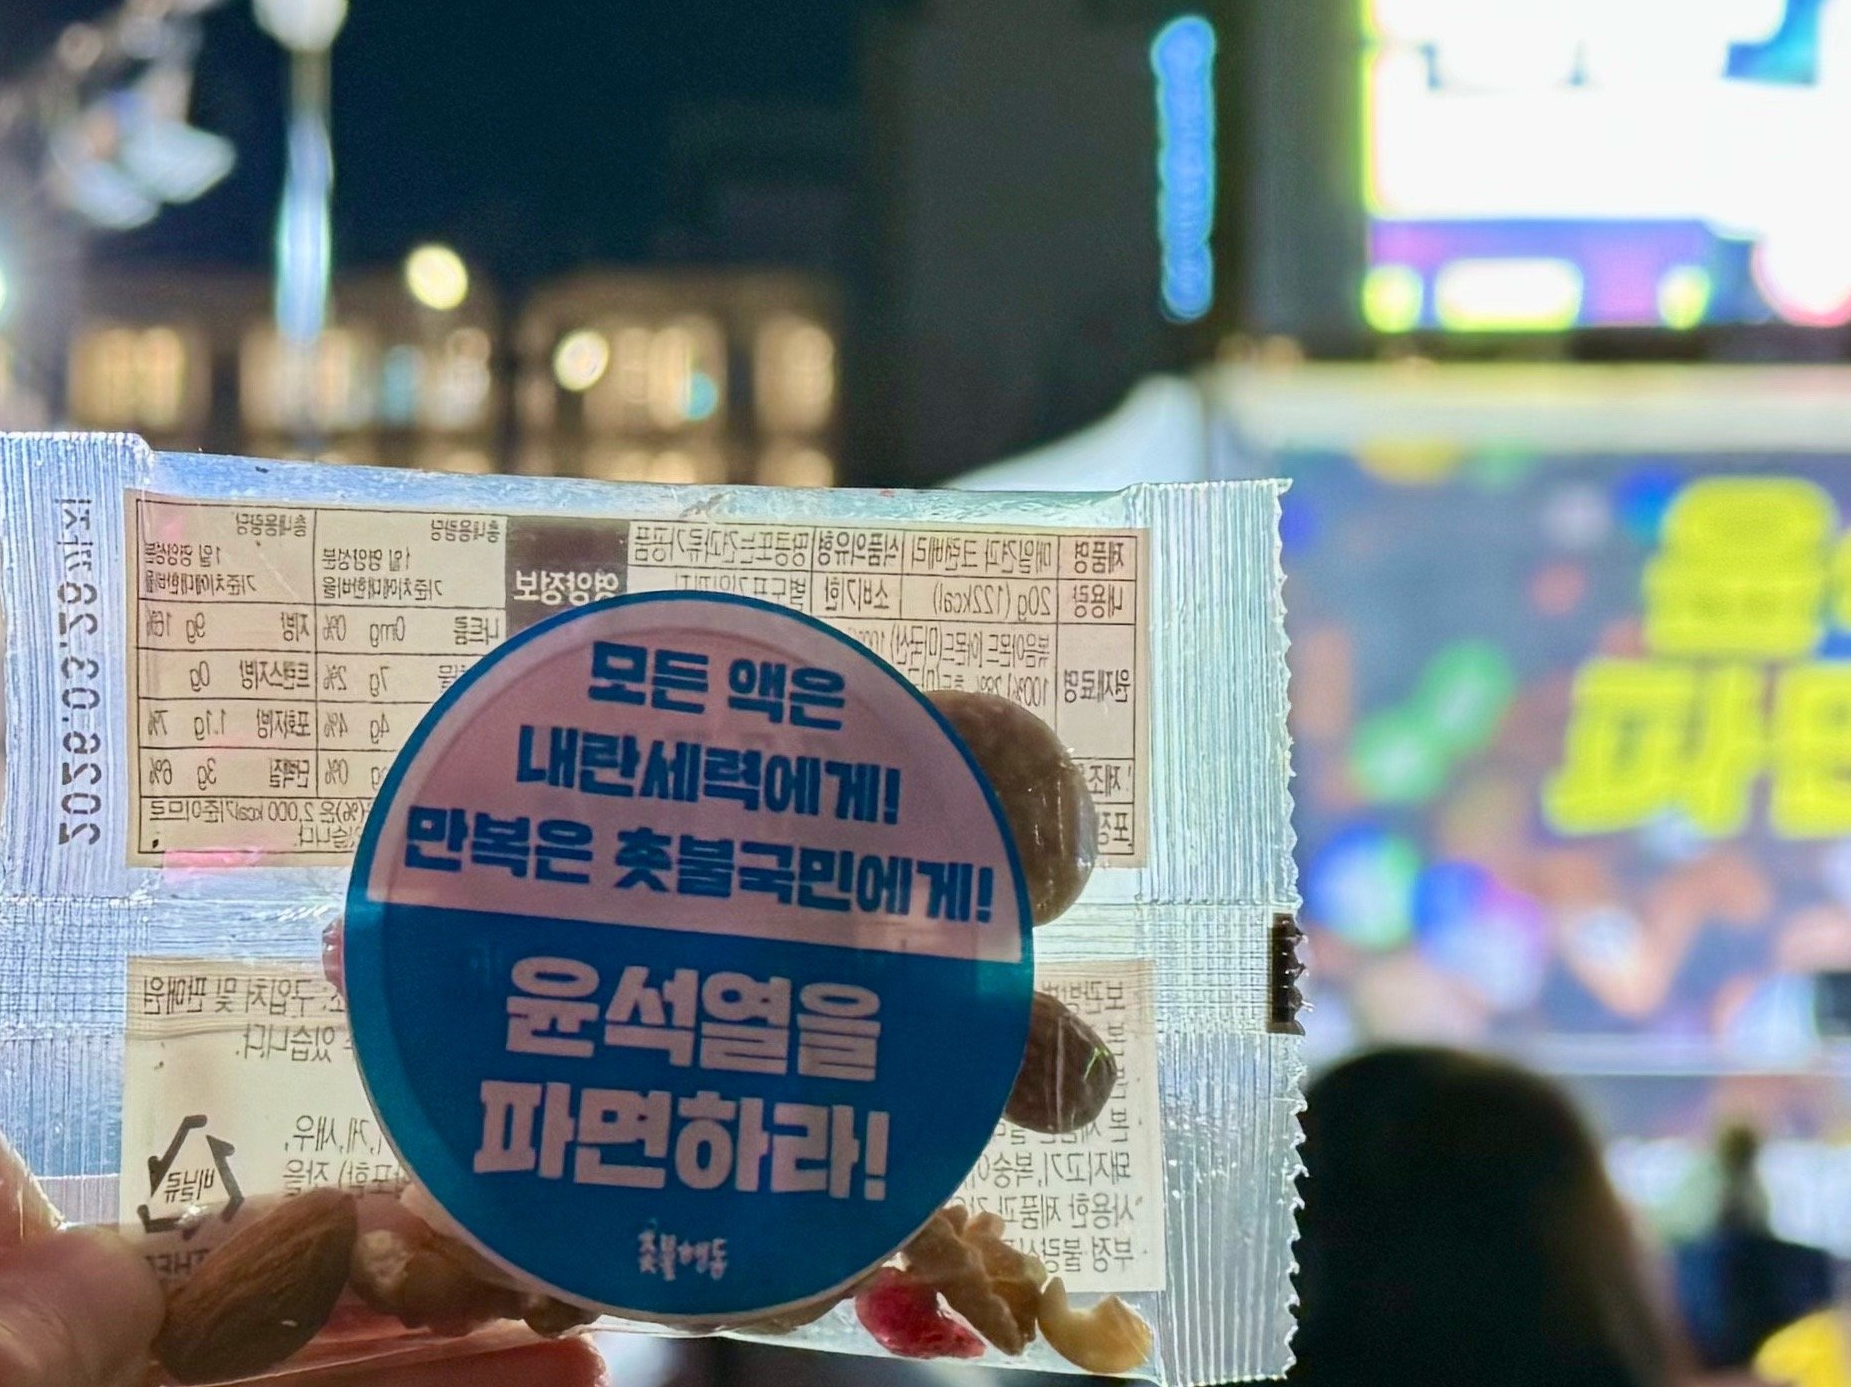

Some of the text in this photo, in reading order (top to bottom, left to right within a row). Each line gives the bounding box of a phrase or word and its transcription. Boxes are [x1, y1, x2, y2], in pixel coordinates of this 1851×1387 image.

[587, 640, 846, 731] 모든 액은
[516, 723, 901, 826] 내란세력에게!
[405, 804, 994, 924] 만복은 촛불국민에게!
[505, 955, 882, 1082] 윤석열을
[473, 1080, 890, 1202] 파면하라!
